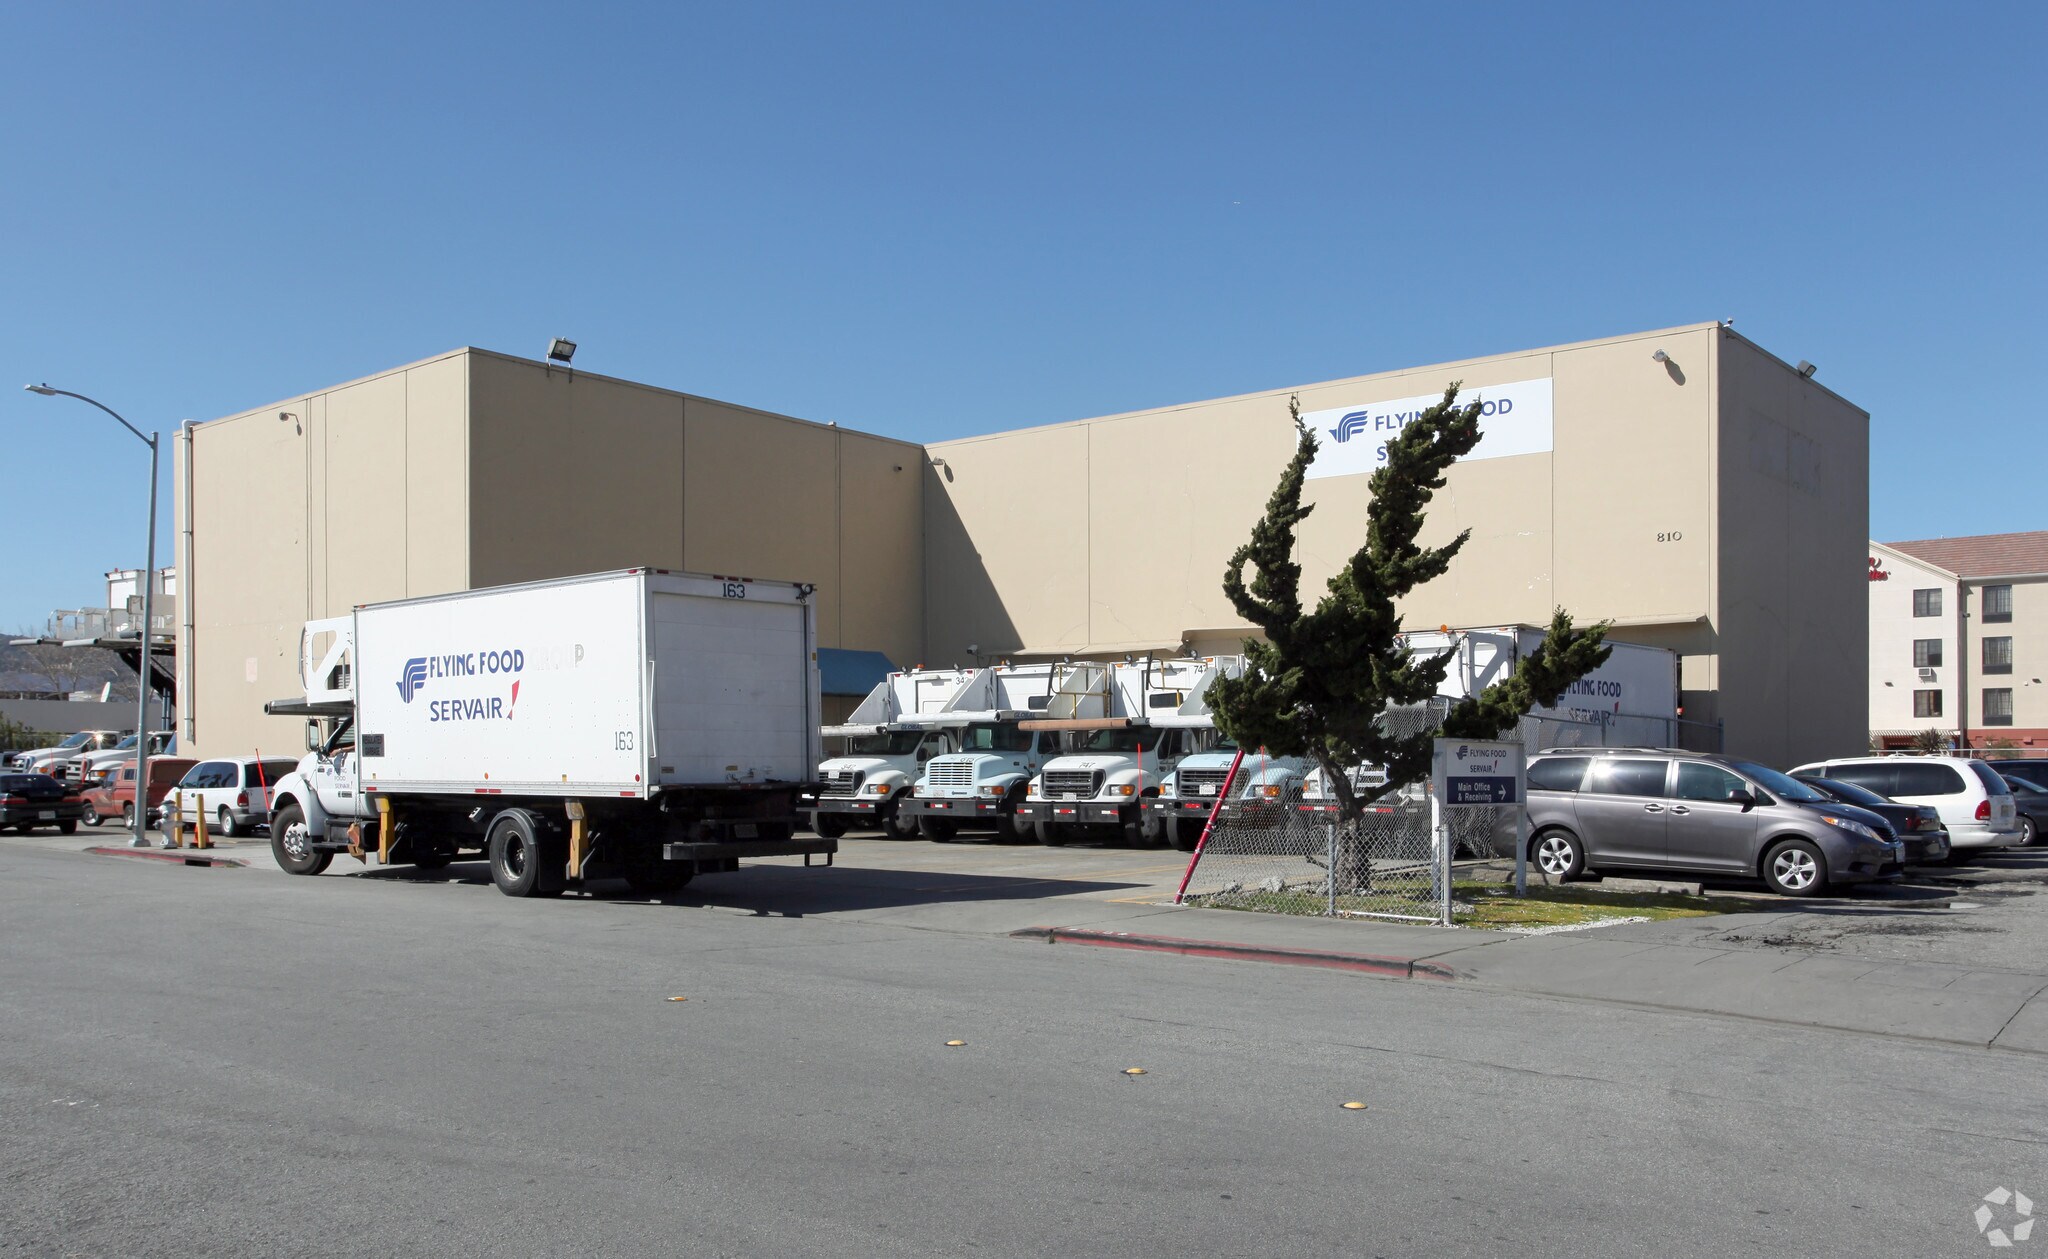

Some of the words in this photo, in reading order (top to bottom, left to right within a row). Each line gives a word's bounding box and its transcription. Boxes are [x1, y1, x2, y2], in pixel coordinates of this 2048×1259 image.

[1375, 410, 1425, 431] FLYIN
[1657, 531, 1682, 542] 810
[722, 583, 745, 598] 163
[430, 653, 475, 678] FLYING
[480, 649, 524, 674] FOOD
[1598, 681, 1622, 697] FOOD
[430, 697, 502, 722] SERVAIR
[615, 731, 634, 750] 163
[1470, 749, 1489, 758] FLYING
[1491, 750, 1507, 758] FOOD
[1470, 764, 1493, 773] SERVAIR
[1458, 782, 1472, 791] Main
[1474, 782, 1491, 791] Office
[1458, 793, 1462, 801] &
[1465, 793, 1492, 802] Receiving
